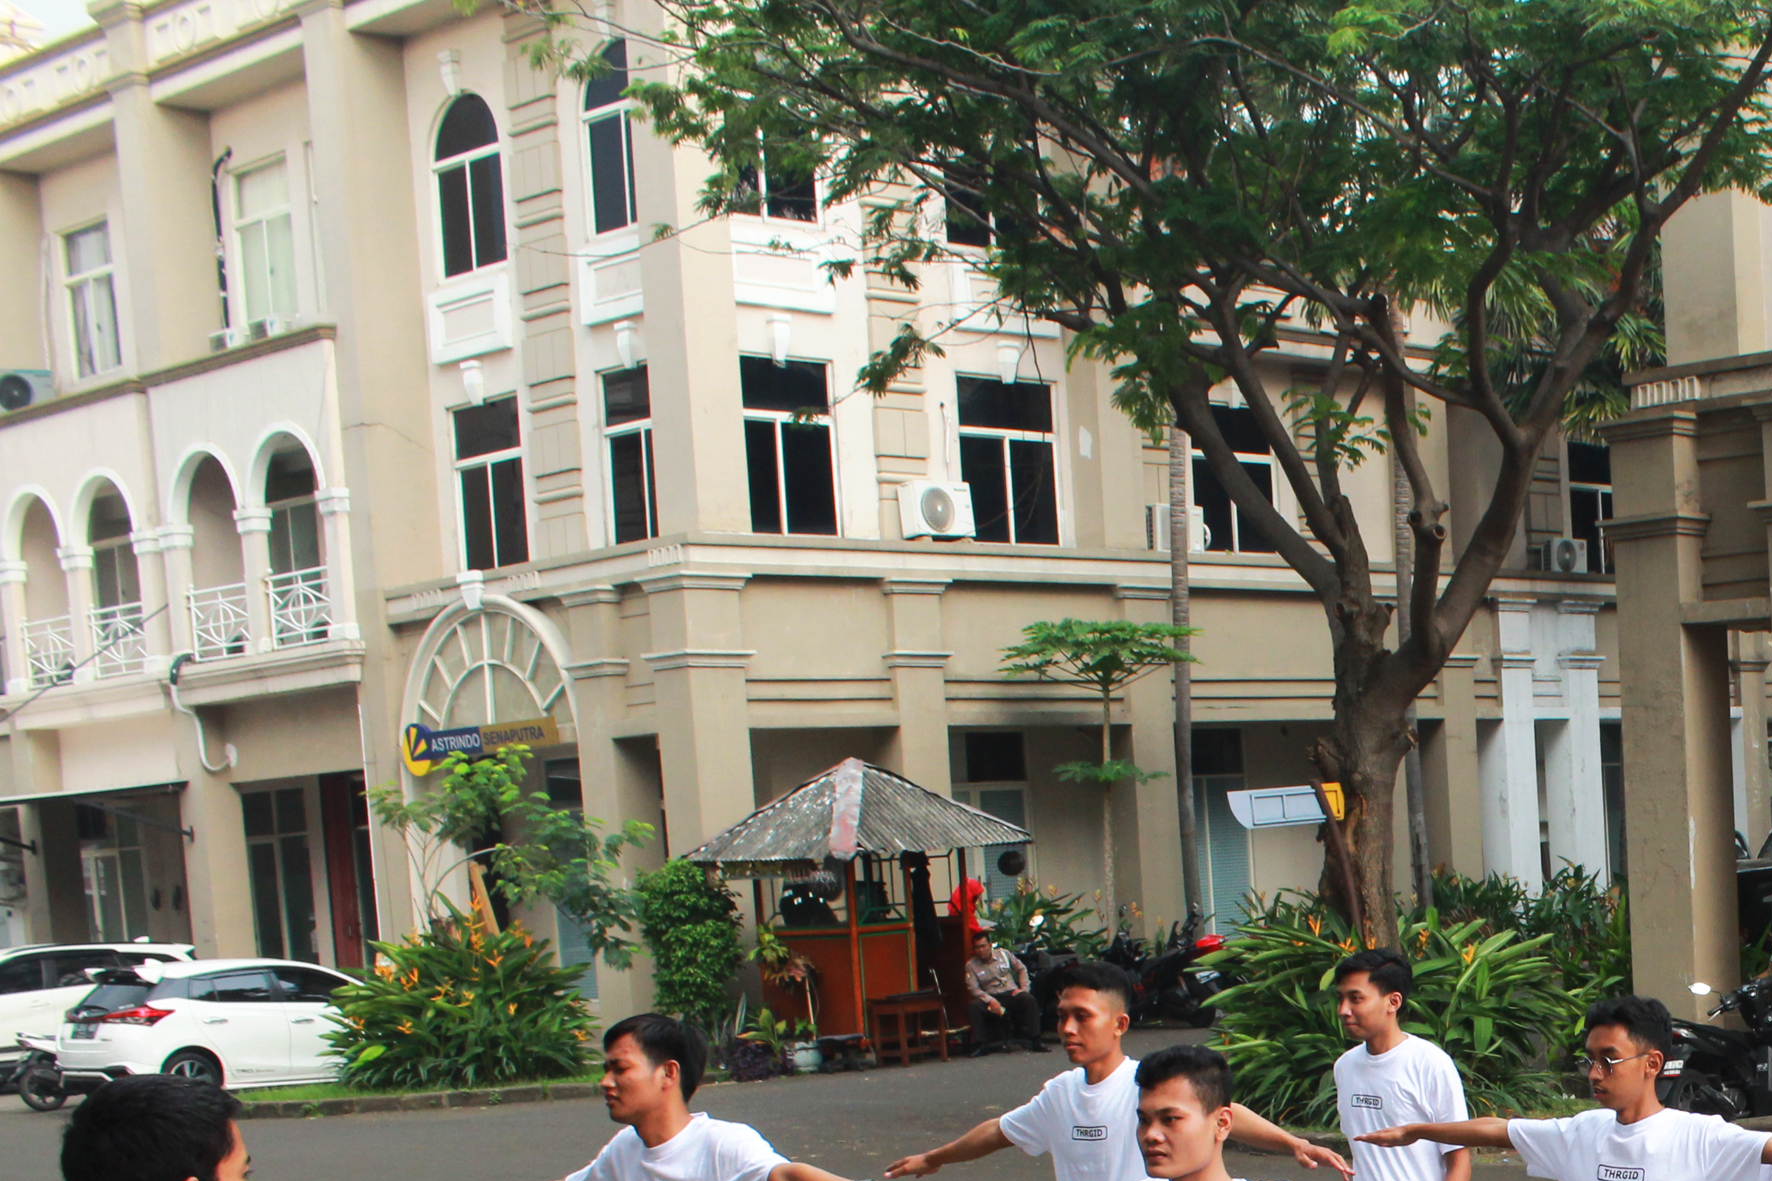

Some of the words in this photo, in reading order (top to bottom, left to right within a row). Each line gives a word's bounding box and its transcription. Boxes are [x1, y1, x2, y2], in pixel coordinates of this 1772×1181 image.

[431, 732, 481, 752] ASTRINDO
[483, 725, 545, 746] SENAPUTRA
[1356, 1096, 1380, 1107] THRGID
[1075, 1128, 1103, 1137] THRGID
[1604, 1168, 1639, 1180] THRGID
